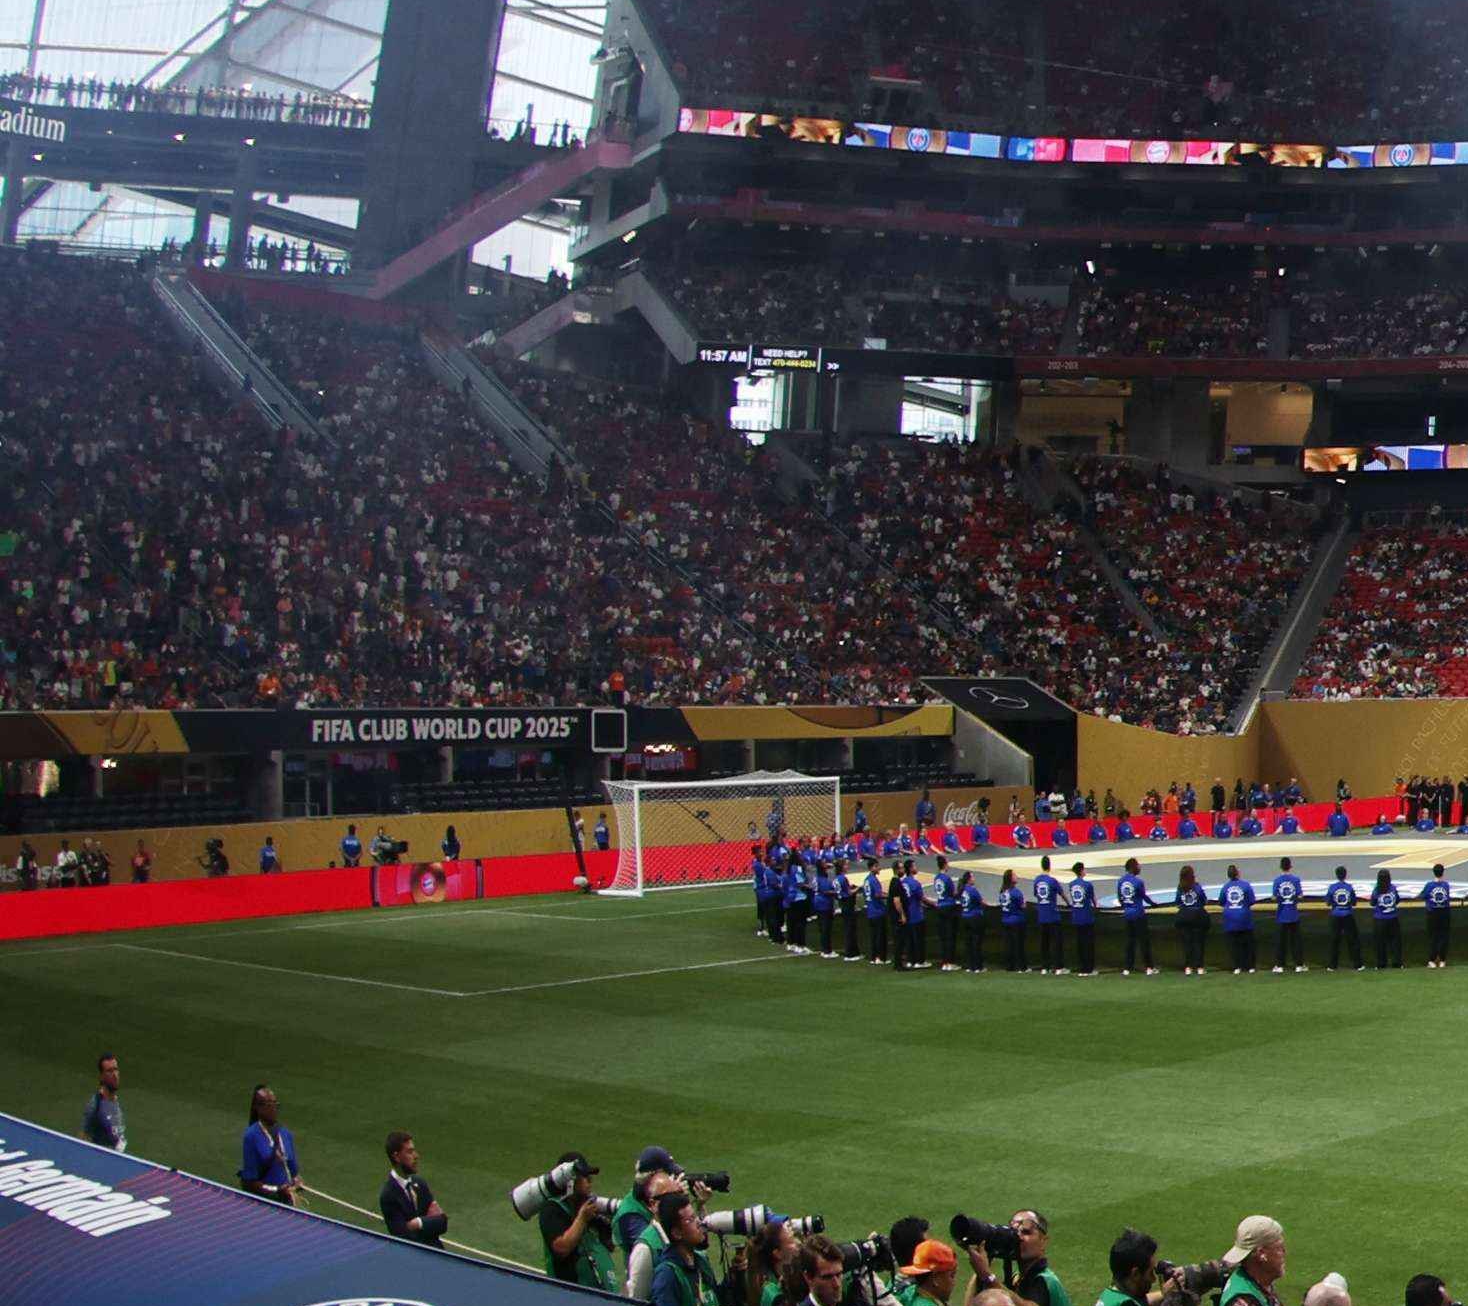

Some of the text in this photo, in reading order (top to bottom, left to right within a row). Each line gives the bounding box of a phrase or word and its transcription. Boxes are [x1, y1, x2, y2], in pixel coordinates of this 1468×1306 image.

[700, 349, 747, 364] 11:57 AM
[754, 357, 772, 367] TEXT
[312, 718, 355, 743] FIFA
[358, 717, 408, 742] CLUB
[411, 717, 480, 741] WORLD
[484, 716, 522, 740] CUP
